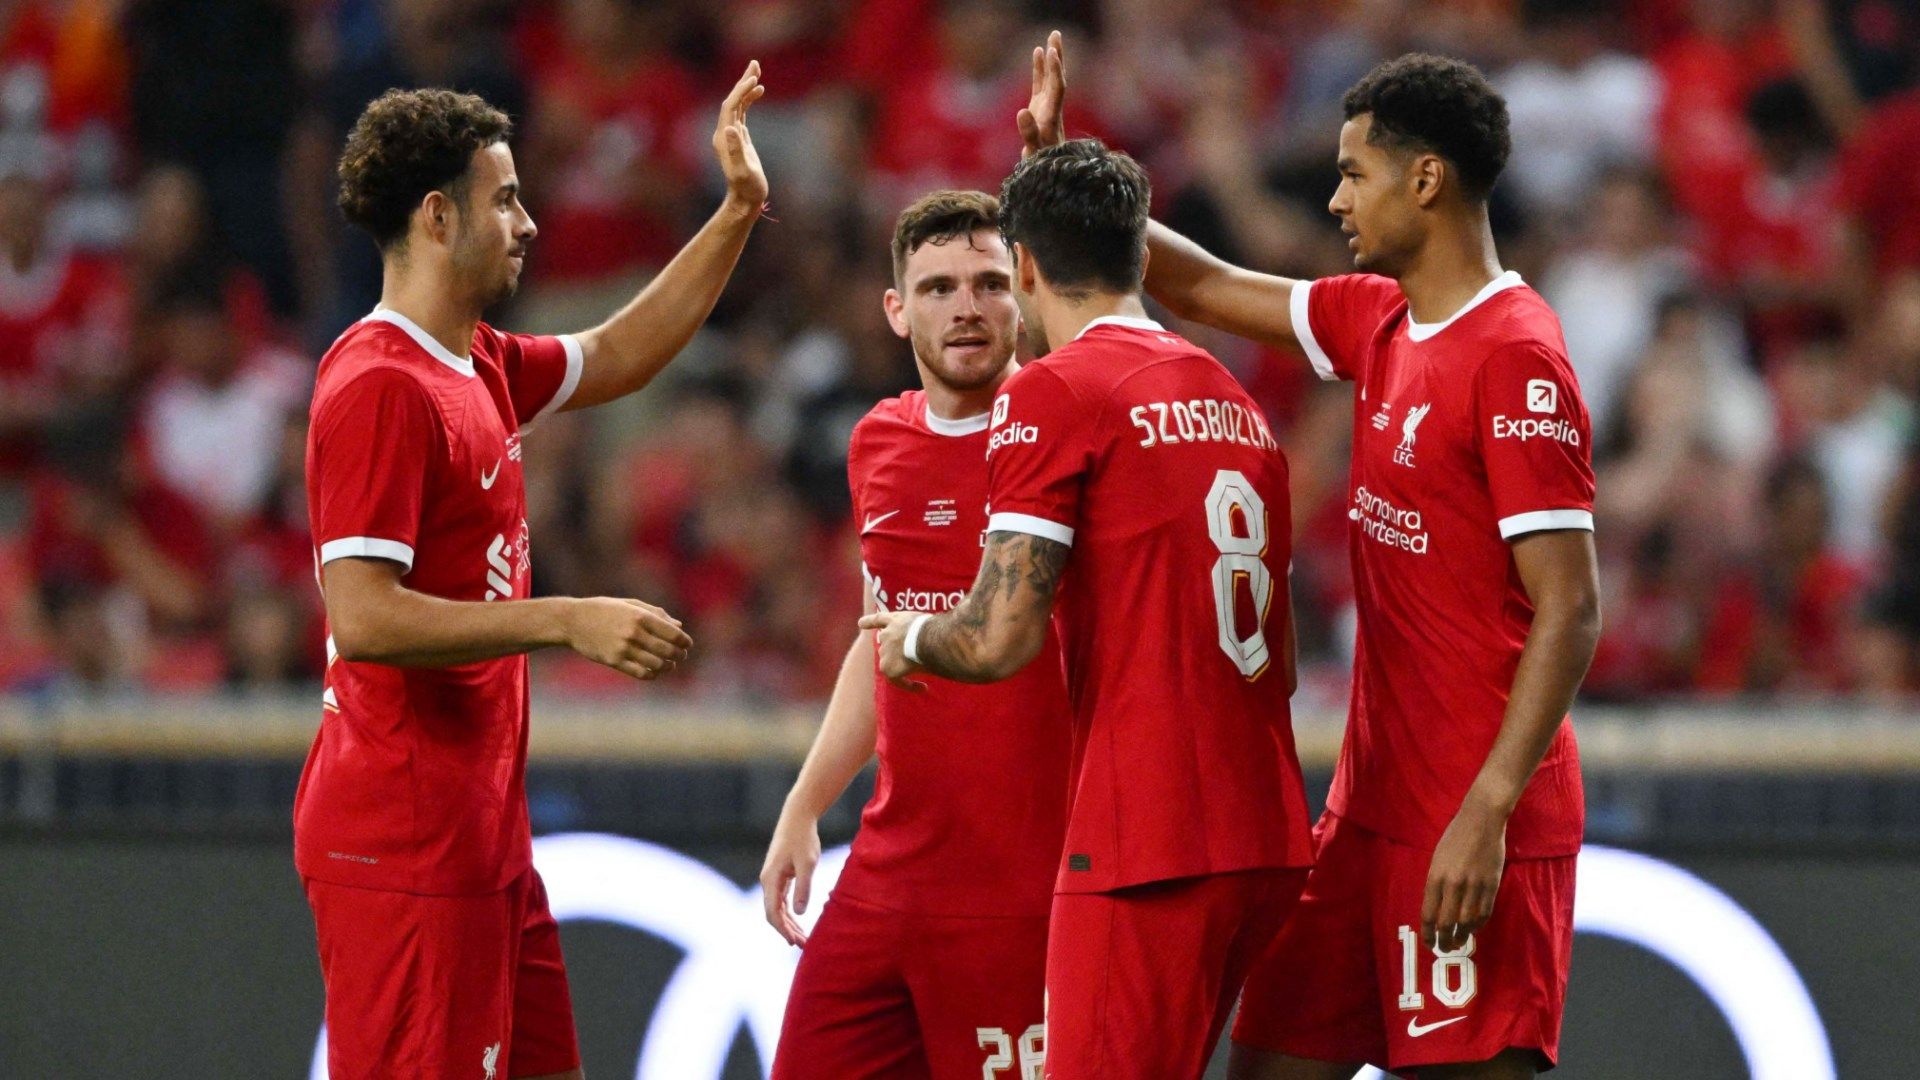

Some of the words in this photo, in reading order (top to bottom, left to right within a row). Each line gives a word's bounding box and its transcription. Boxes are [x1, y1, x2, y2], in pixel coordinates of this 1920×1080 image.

[1492, 414, 1581, 447] Expedia
[1356, 508, 1428, 555] hartered
[1205, 469, 1274, 682] 8
[1398, 924, 1478, 1011] 18
